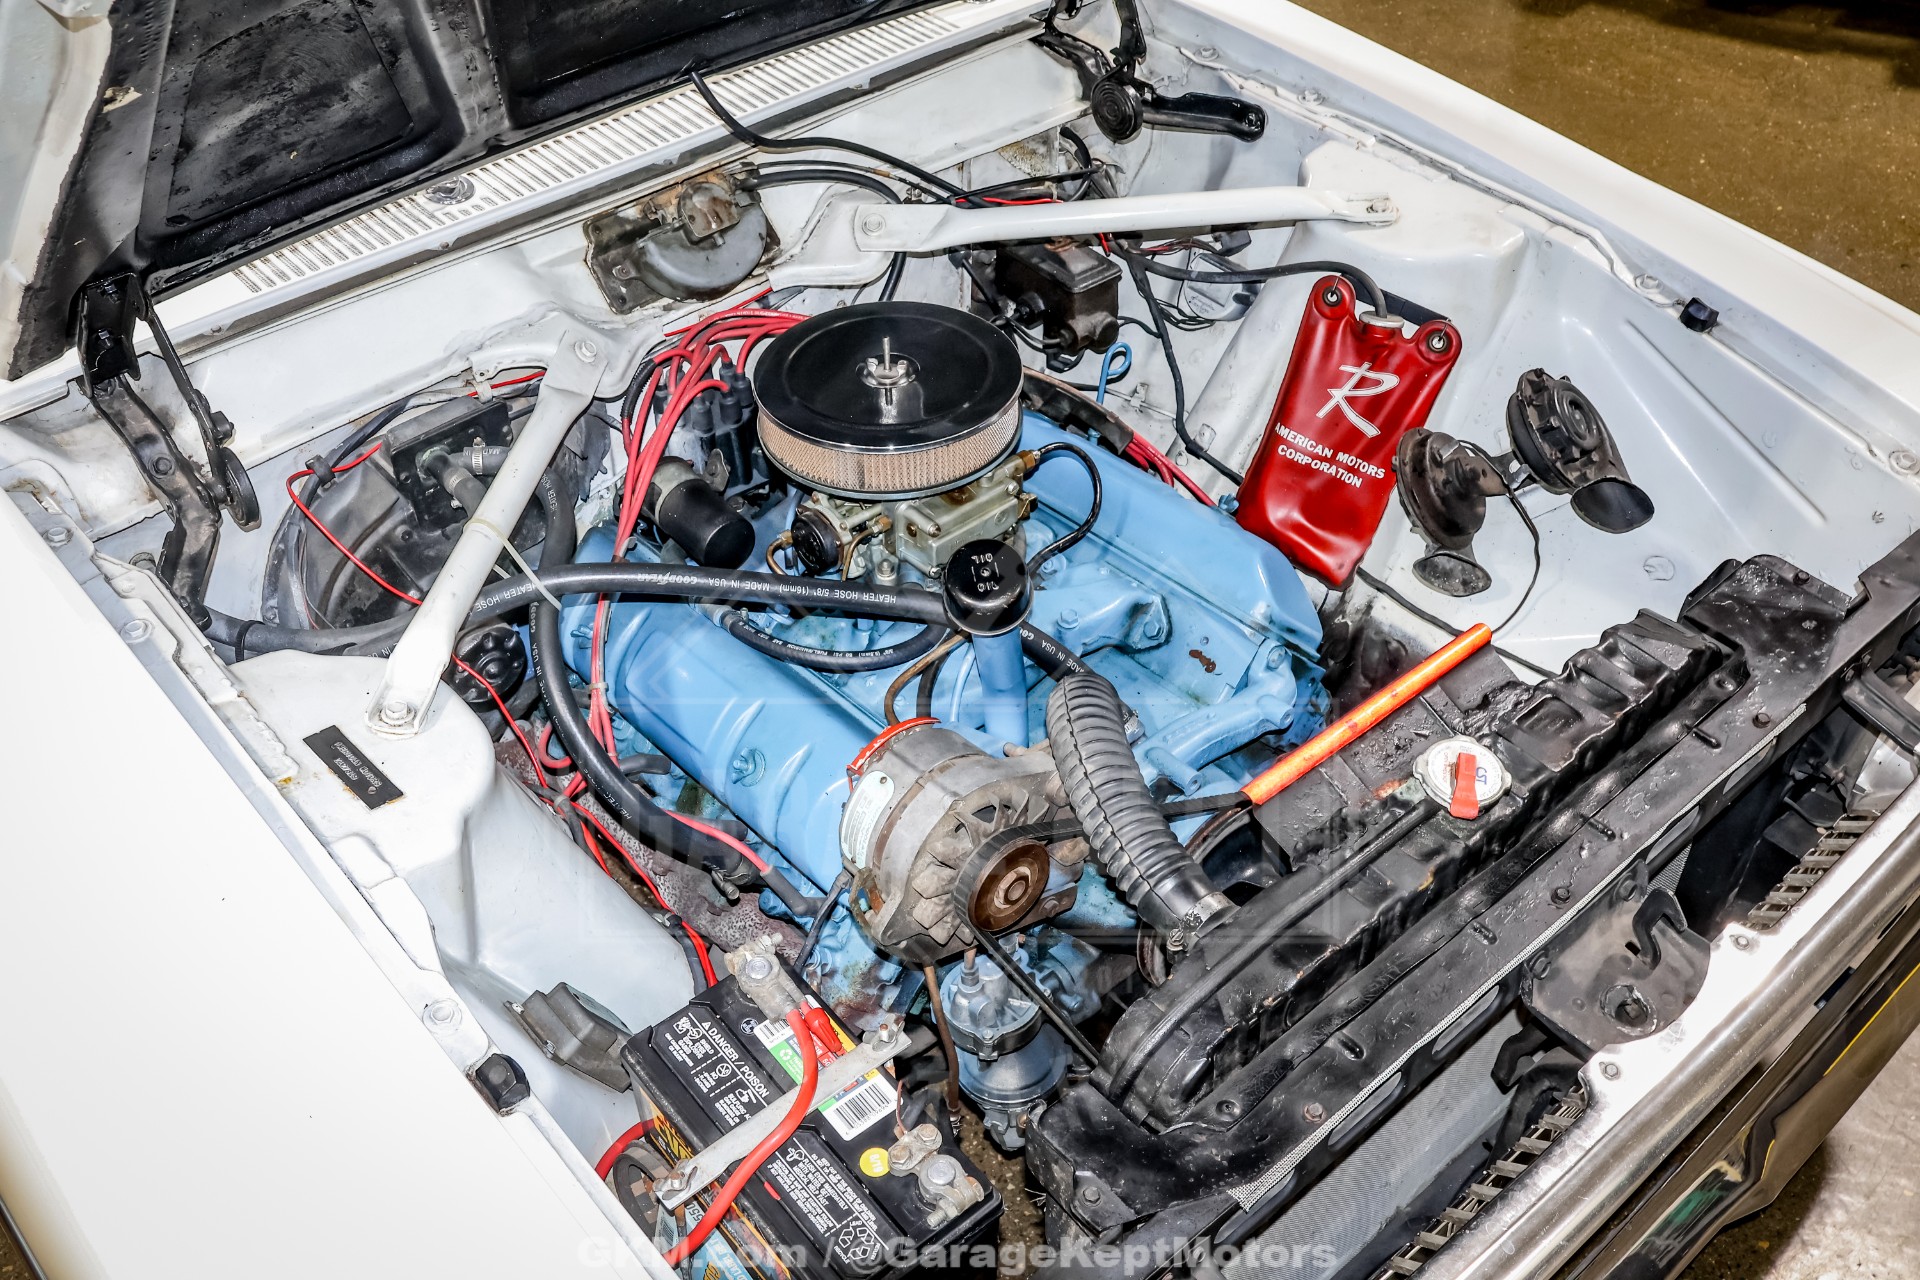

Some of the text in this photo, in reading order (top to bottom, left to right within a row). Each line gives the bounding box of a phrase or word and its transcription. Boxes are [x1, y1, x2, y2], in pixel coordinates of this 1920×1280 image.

[1316, 361, 1400, 438] R
[482, 446, 500, 456] MAD
[1275, 422, 1386, 479] AMERICAN MOTORS
[1277, 444, 1363, 488] CORPORATION
[547, 488, 558, 511] HEATER
[637, 571, 697, 584] GOODYEAR
[707, 576, 726, 587] USA
[730, 579, 739, 588] IN
[744, 580, 769, 591] MADE
[778, 582, 809, 596] (16mm)
[833, 589, 857, 600] HOSE
[474, 594, 500, 611] HOSE
[862, 591, 896, 604] HEATER
[1039, 639, 1056, 654] USA
[1056, 650, 1066, 660] IN
[707, 1026, 739, 1062] DANGER
[739, 1064, 770, 1098] POISON
[726, 1092, 747, 1115] SULFURIC
[792, 1164, 829, 1207] MEDICAL HELP FAST
[797, 1161, 809, 1174] WITH
[819, 1187, 830, 1198] GET
[802, 1157, 848, 1211] FLUSH EYES IMMEDIATELY
